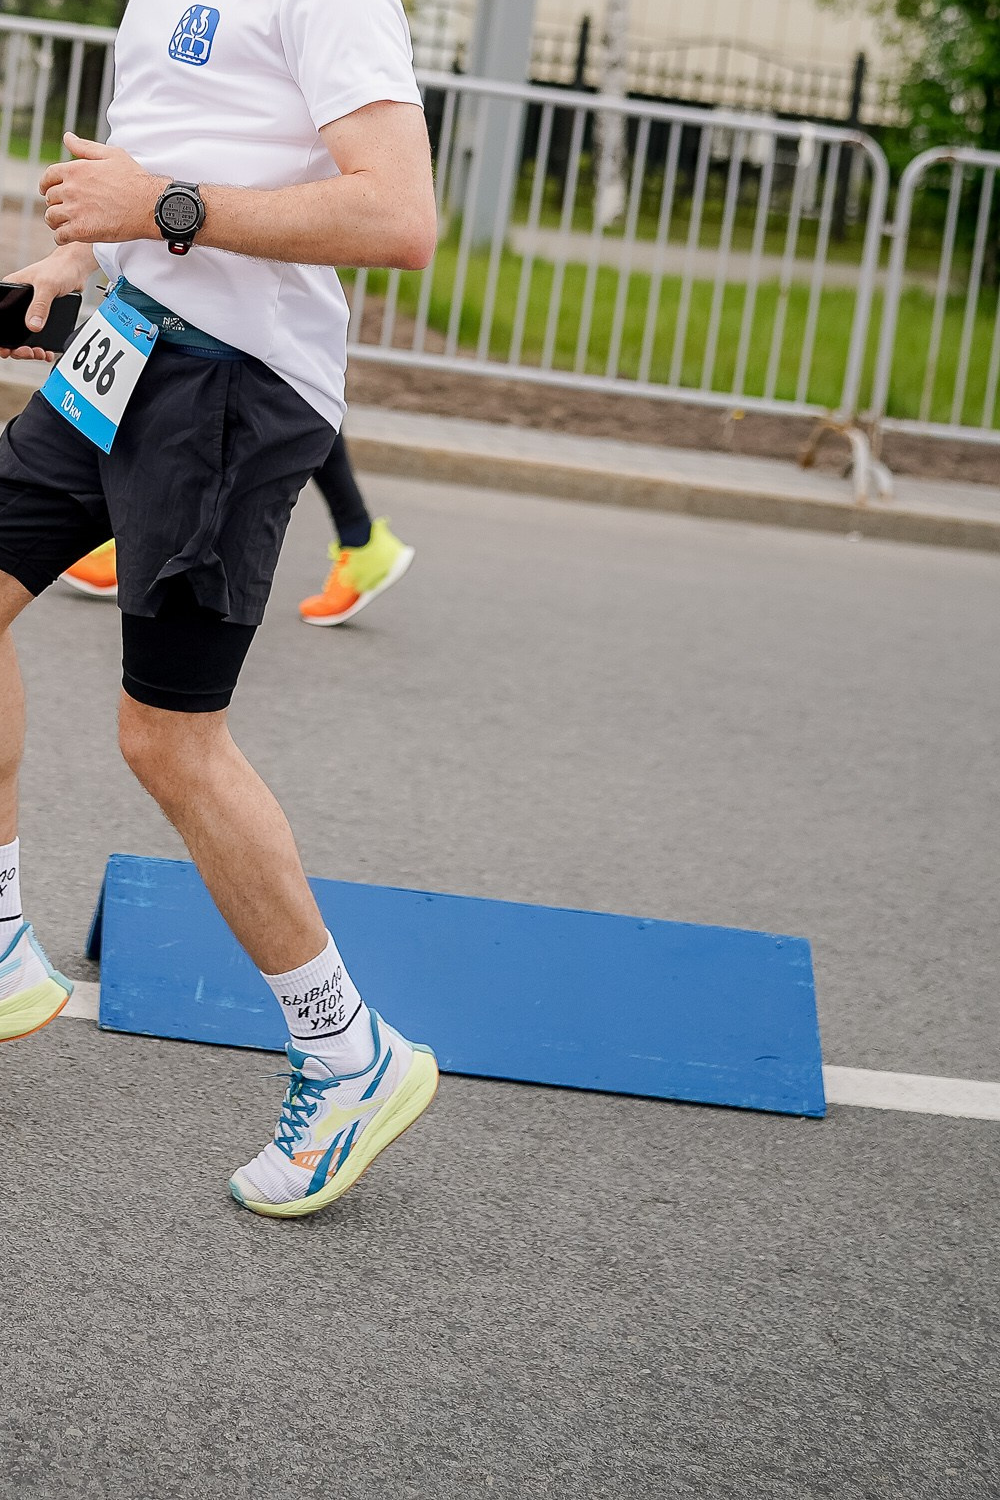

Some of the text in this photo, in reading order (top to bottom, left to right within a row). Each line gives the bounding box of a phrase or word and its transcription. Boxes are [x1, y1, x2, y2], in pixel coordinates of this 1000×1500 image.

[72, 328, 125, 396] 636
[280, 965, 342, 1006] БЫВАЛО
[297, 985, 344, 1019] И ПОХ
[310, 1004, 346, 1031] УЖЕ
